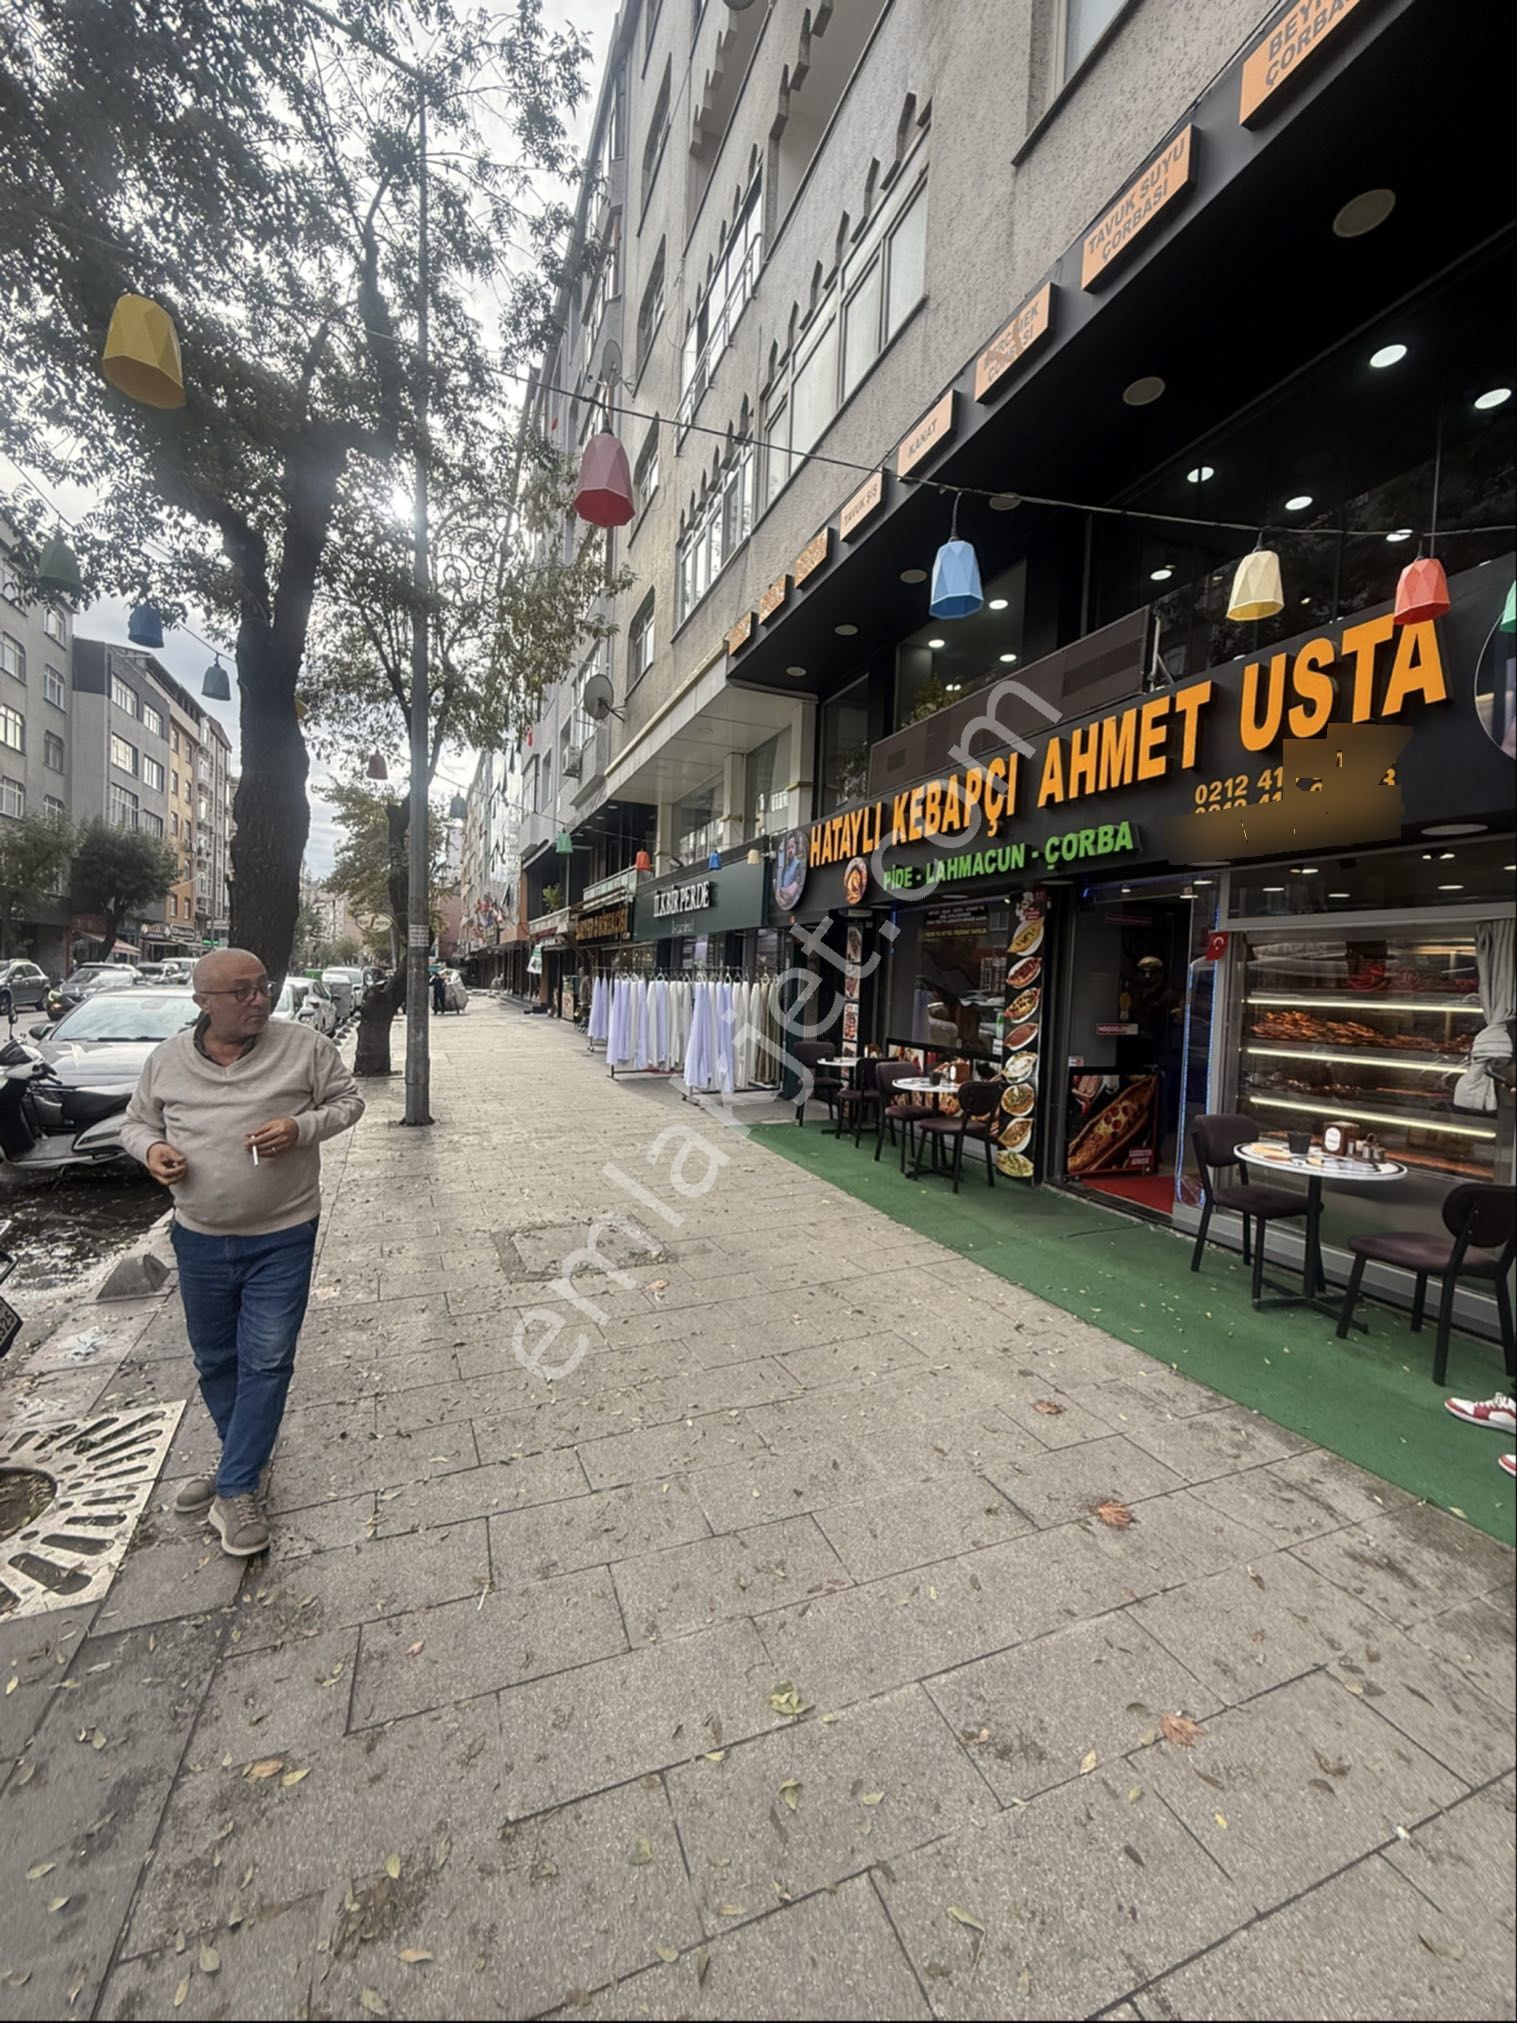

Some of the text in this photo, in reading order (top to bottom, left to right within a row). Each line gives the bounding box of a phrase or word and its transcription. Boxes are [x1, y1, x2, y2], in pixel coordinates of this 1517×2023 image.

[1266, 0, 1350, 87] ÇORBA
[1088, 137, 1185, 255] TAVUK SUYU
[1102, 178, 1169, 261] ÇORBASI
[908, 418, 938, 459] KANAT
[809, 612, 1447, 868] HATAYLI KEBAPÇI AHMET USTA
[1195, 774, 1249, 806] 0212
[883, 862, 913, 891] PİDE
[926, 842, 1025, 885] LAHMACUN
[1044, 820, 1134, 871] ÇORBA
